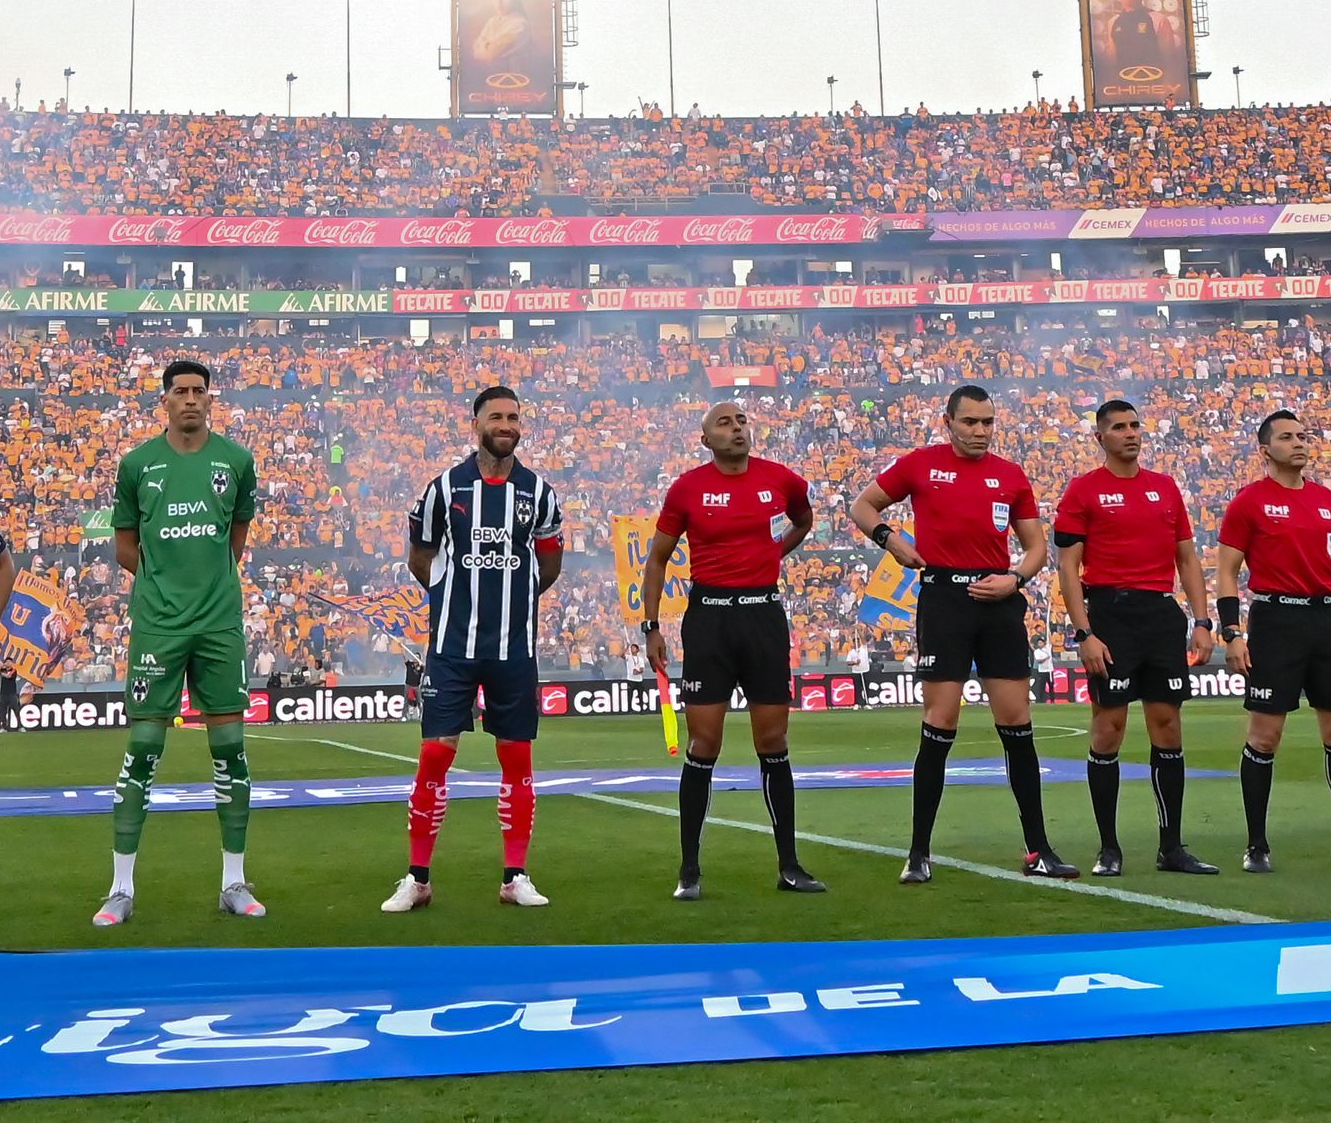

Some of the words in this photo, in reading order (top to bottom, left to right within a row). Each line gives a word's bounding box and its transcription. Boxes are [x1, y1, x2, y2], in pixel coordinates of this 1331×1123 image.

[469, 92, 547, 102] CHIREY
[1103, 85, 1180, 96] CHIREY
[208, 220, 283, 244] Coca-Cola
[304, 220, 379, 244] Coca-Cola
[400, 220, 476, 244] Coca-Cola
[496, 220, 570, 244] Coca-Cola
[589, 219, 663, 243] Coca-Cola
[683, 218, 757, 242] Coca-Cola
[776, 217, 853, 241] Coca-Cola
[939, 222, 981, 232] HECHOS
[984, 222, 997, 231] DE
[1001, 221, 1030, 230] ALGO
[1092, 219, 1132, 230] CEMEX
[1146, 219, 1188, 228] HECHOS
[1191, 218, 1205, 227] DE
[1211, 217, 1239, 227] ALGO
[26, 292, 107, 310] AFIRME
[168, 294, 249, 312] AFIRME
[309, 294, 387, 312] AFIRME
[396, 293, 454, 310] TECATE
[514, 293, 570, 309] TECATE
[630, 291, 687, 308] TECATE
[747, 290, 802, 306] TECATE
[862, 289, 917, 305] TECATE
[977, 285, 1032, 303] TECATE
[1092, 282, 1148, 299] TECATE
[1209, 280, 1265, 297] TECATE
[929, 469, 957, 481] FMF
[703, 493, 730, 505] FMF
[1098, 494, 1124, 505] FMF
[167, 500, 208, 517] BBVA
[1264, 504, 1290, 516] FMF
[159, 521, 217, 539] codere
[471, 527, 512, 544] BBVA
[462, 551, 521, 570] codere
[701, 596, 733, 606] Comex
[738, 593, 769, 605] Comex
[1279, 596, 1311, 606] Comex
[11, 603, 31, 626] U
[682, 680, 702, 692] FMF
[1250, 686, 1273, 698] FMF
[703, 982, 921, 1018] DE
[952, 972, 1165, 1002] LA
